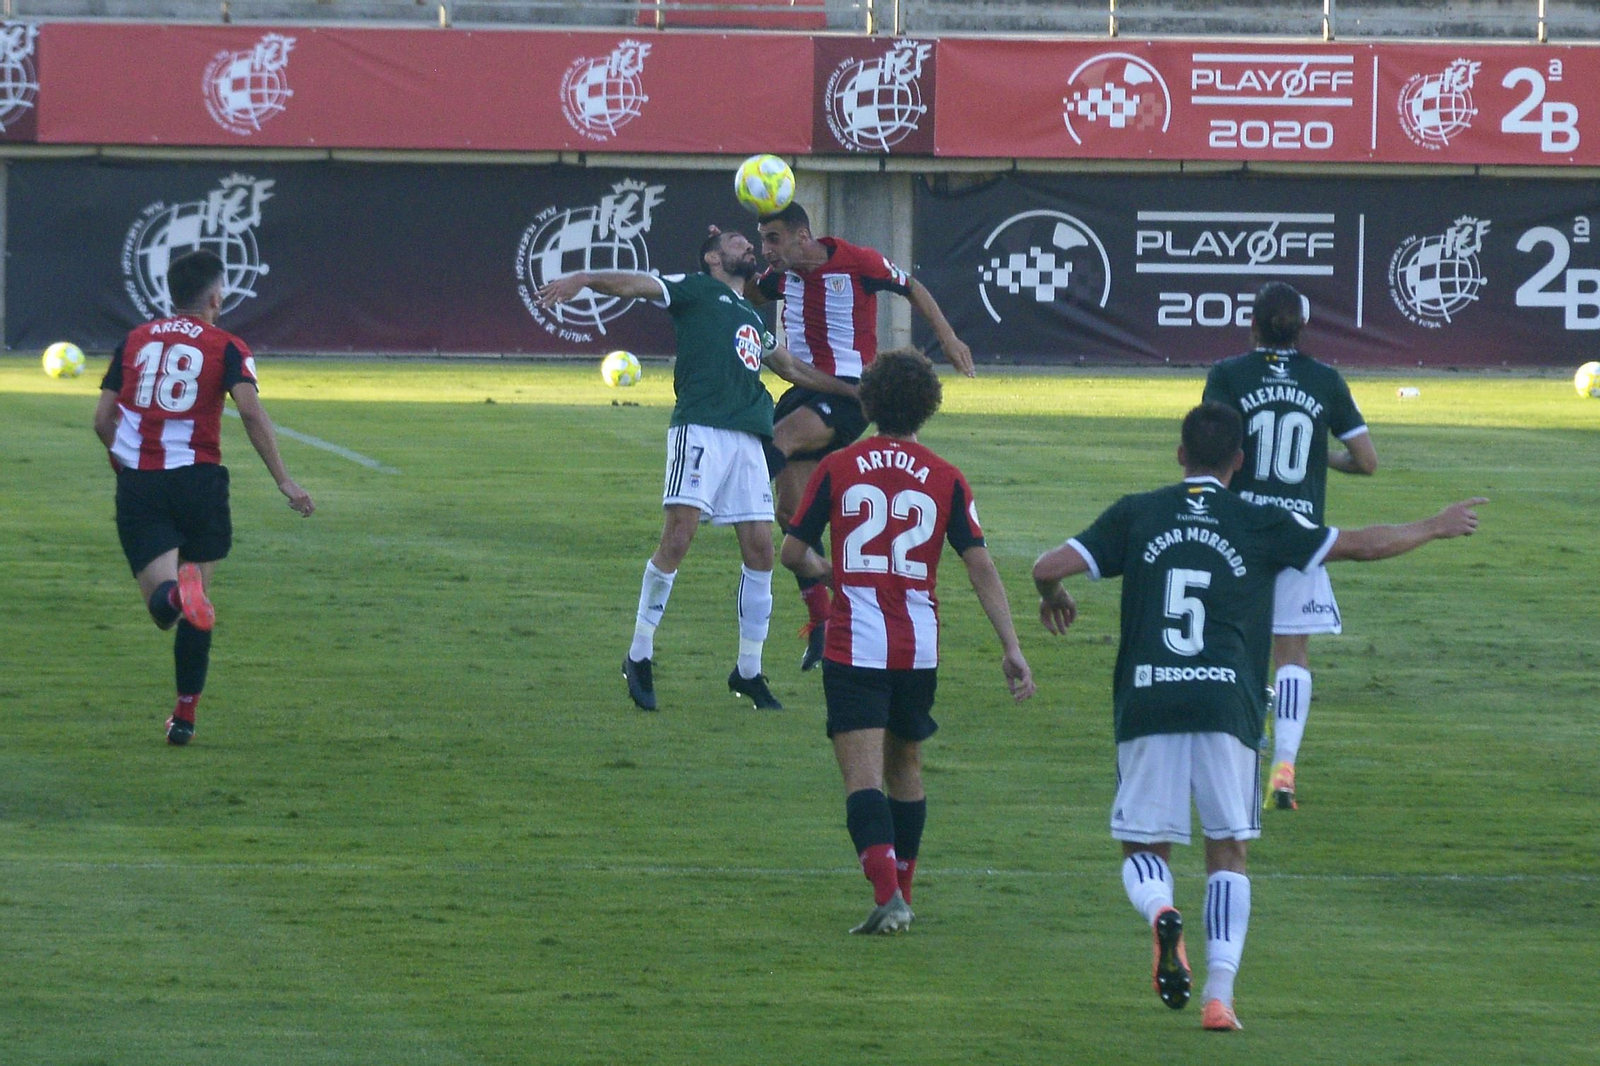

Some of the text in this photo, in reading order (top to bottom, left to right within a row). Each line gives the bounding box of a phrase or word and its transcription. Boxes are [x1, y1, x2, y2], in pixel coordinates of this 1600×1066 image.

[1209, 120, 1334, 149] 2020
[151, 320, 203, 339] ARESO
[559, 328, 593, 343] FÚTBOL
[134, 341, 204, 412] 18
[1239, 385, 1323, 418] ALEXANDRE
[692, 445, 705, 470] 7
[1248, 410, 1314, 484] 10
[856, 450, 930, 484] ARTOLA
[842, 483, 937, 580] 22
[1143, 527, 1247, 578] CÉSAR MORGADO
[1162, 567, 1212, 657] 5
[1155, 666, 1236, 684] BESOCCER
